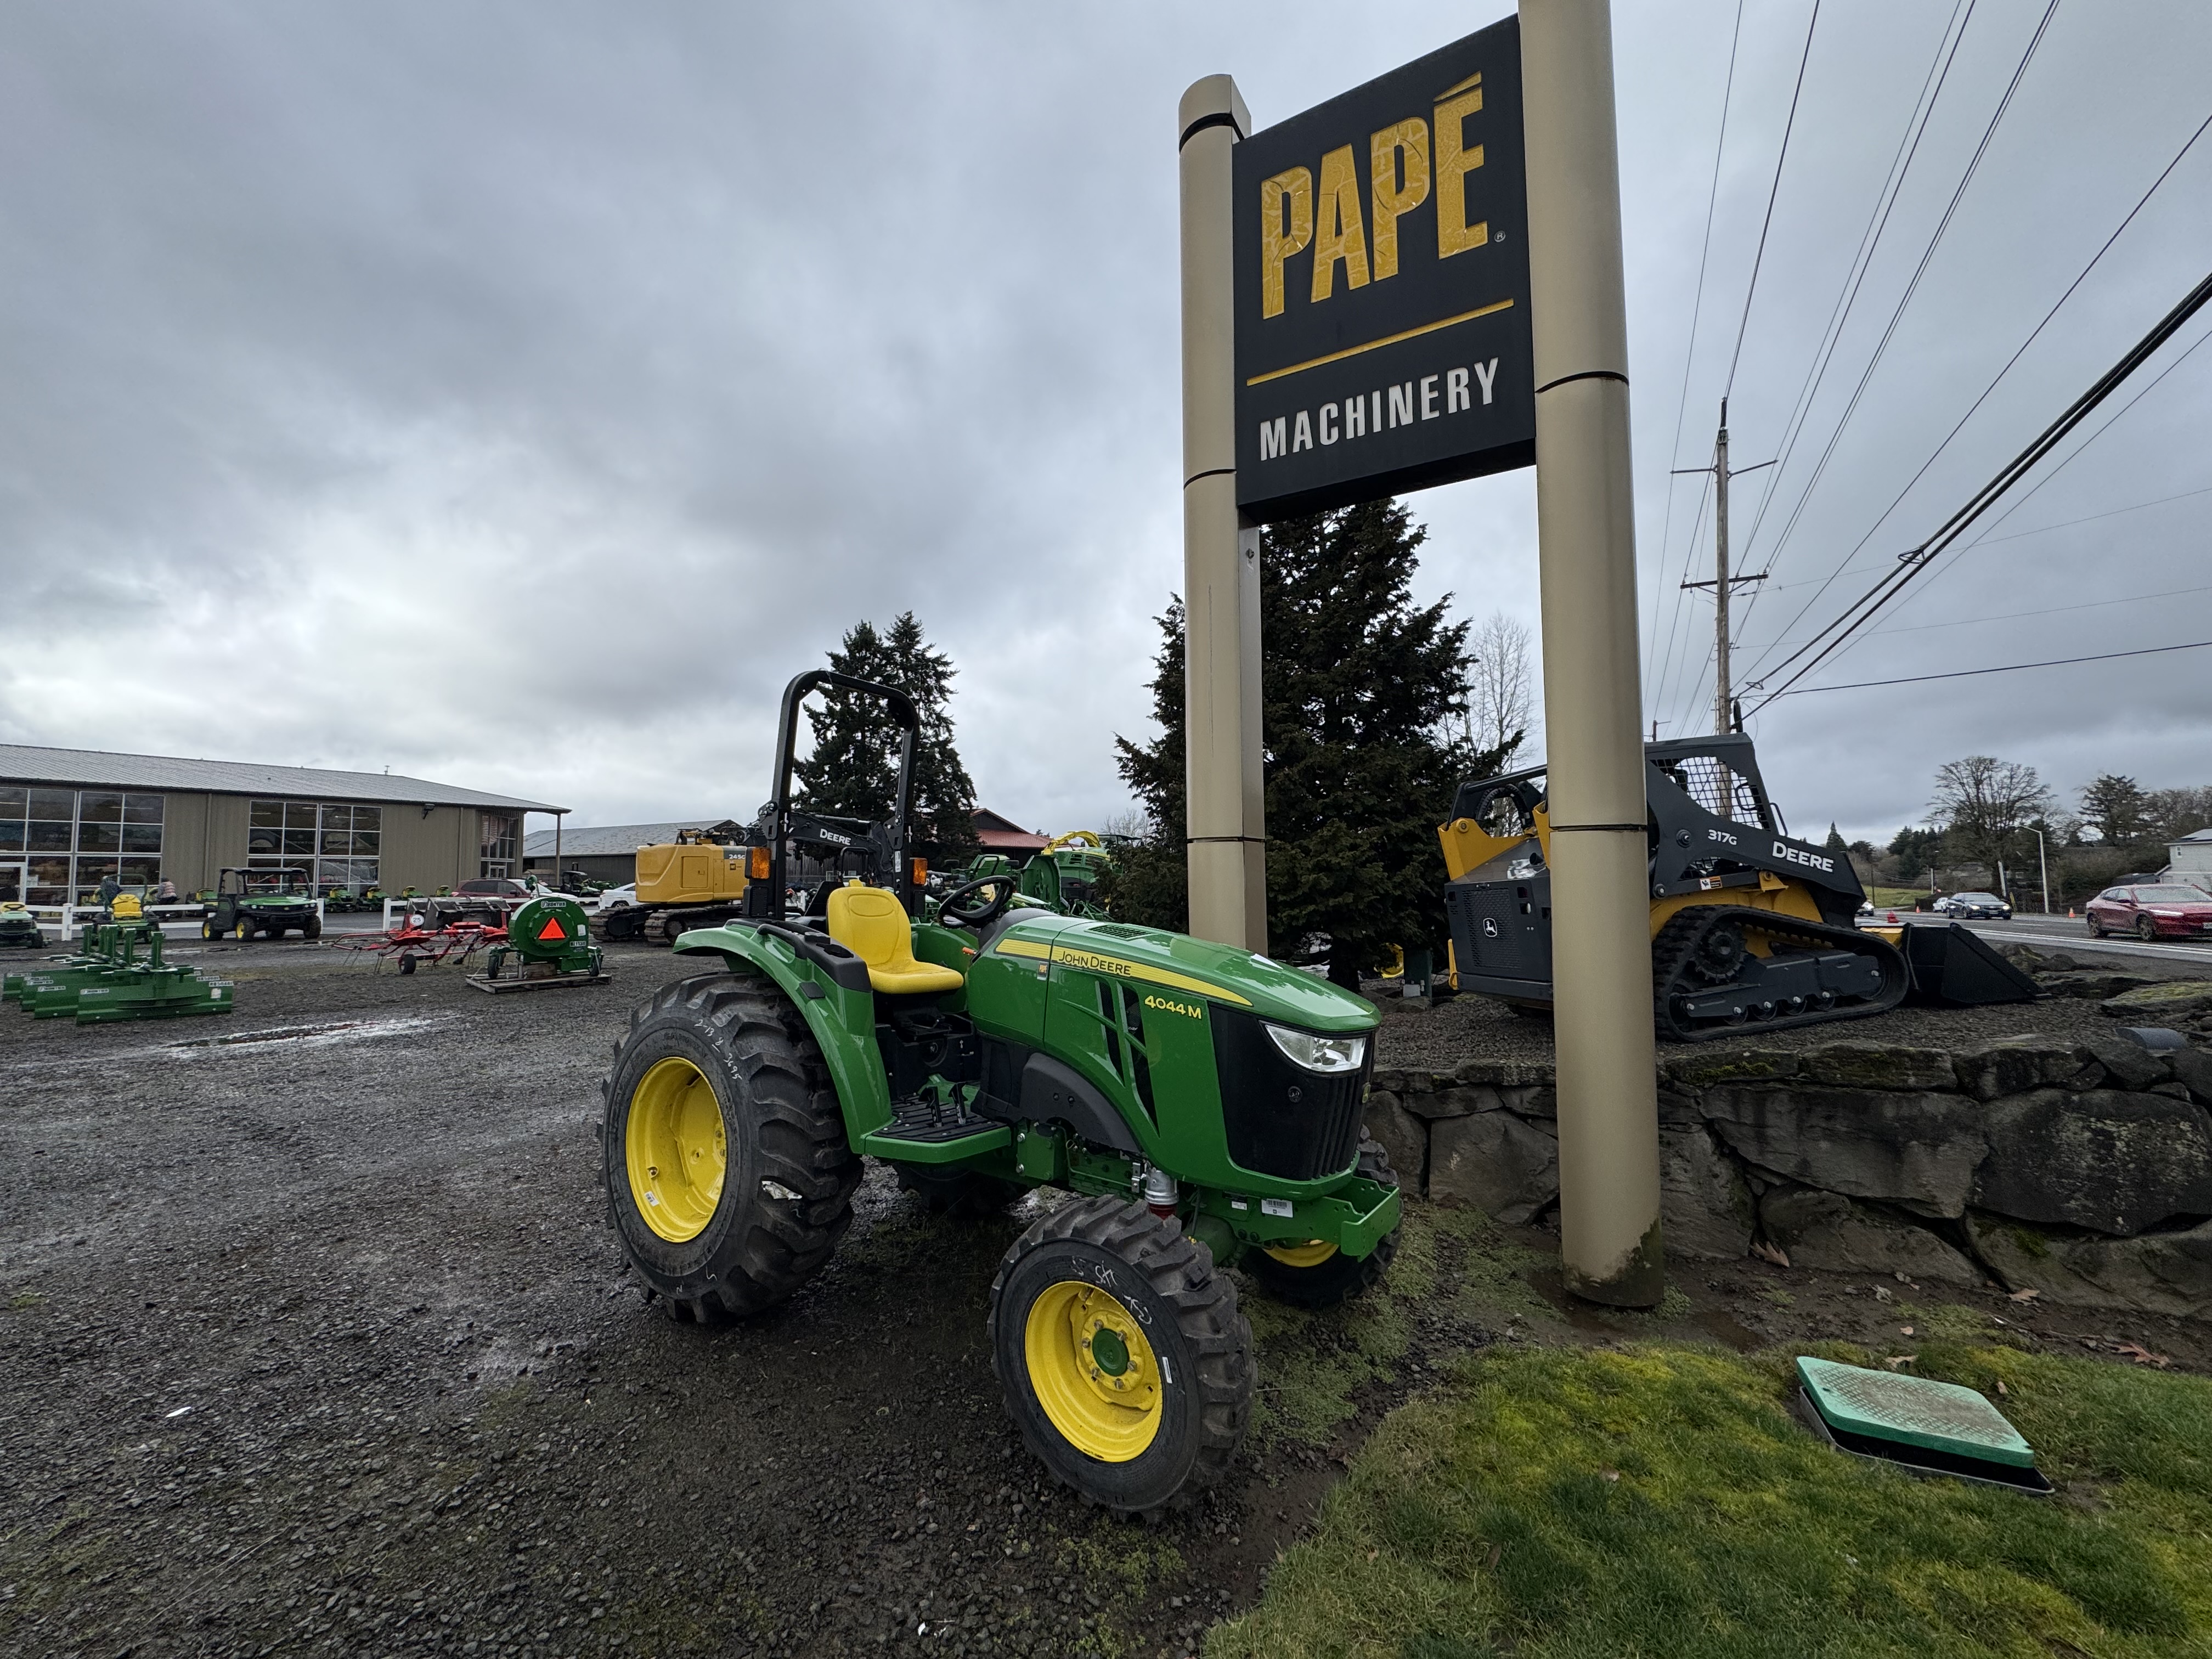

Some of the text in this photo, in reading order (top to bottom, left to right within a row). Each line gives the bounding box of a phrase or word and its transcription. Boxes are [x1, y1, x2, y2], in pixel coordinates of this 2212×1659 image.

[1261, 70, 1488, 320] PAPÉ
[1261, 357, 1498, 461] MACHINERY
[820, 828, 851, 845] DEERE
[1708, 830, 1737, 845] 317G
[1773, 842, 1833, 872] DEERE
[1058, 951, 1132, 975] JOHN DEERE
[693, 1019, 715, 1036] 2-13
[723, 1052, 743, 1080] 3695
